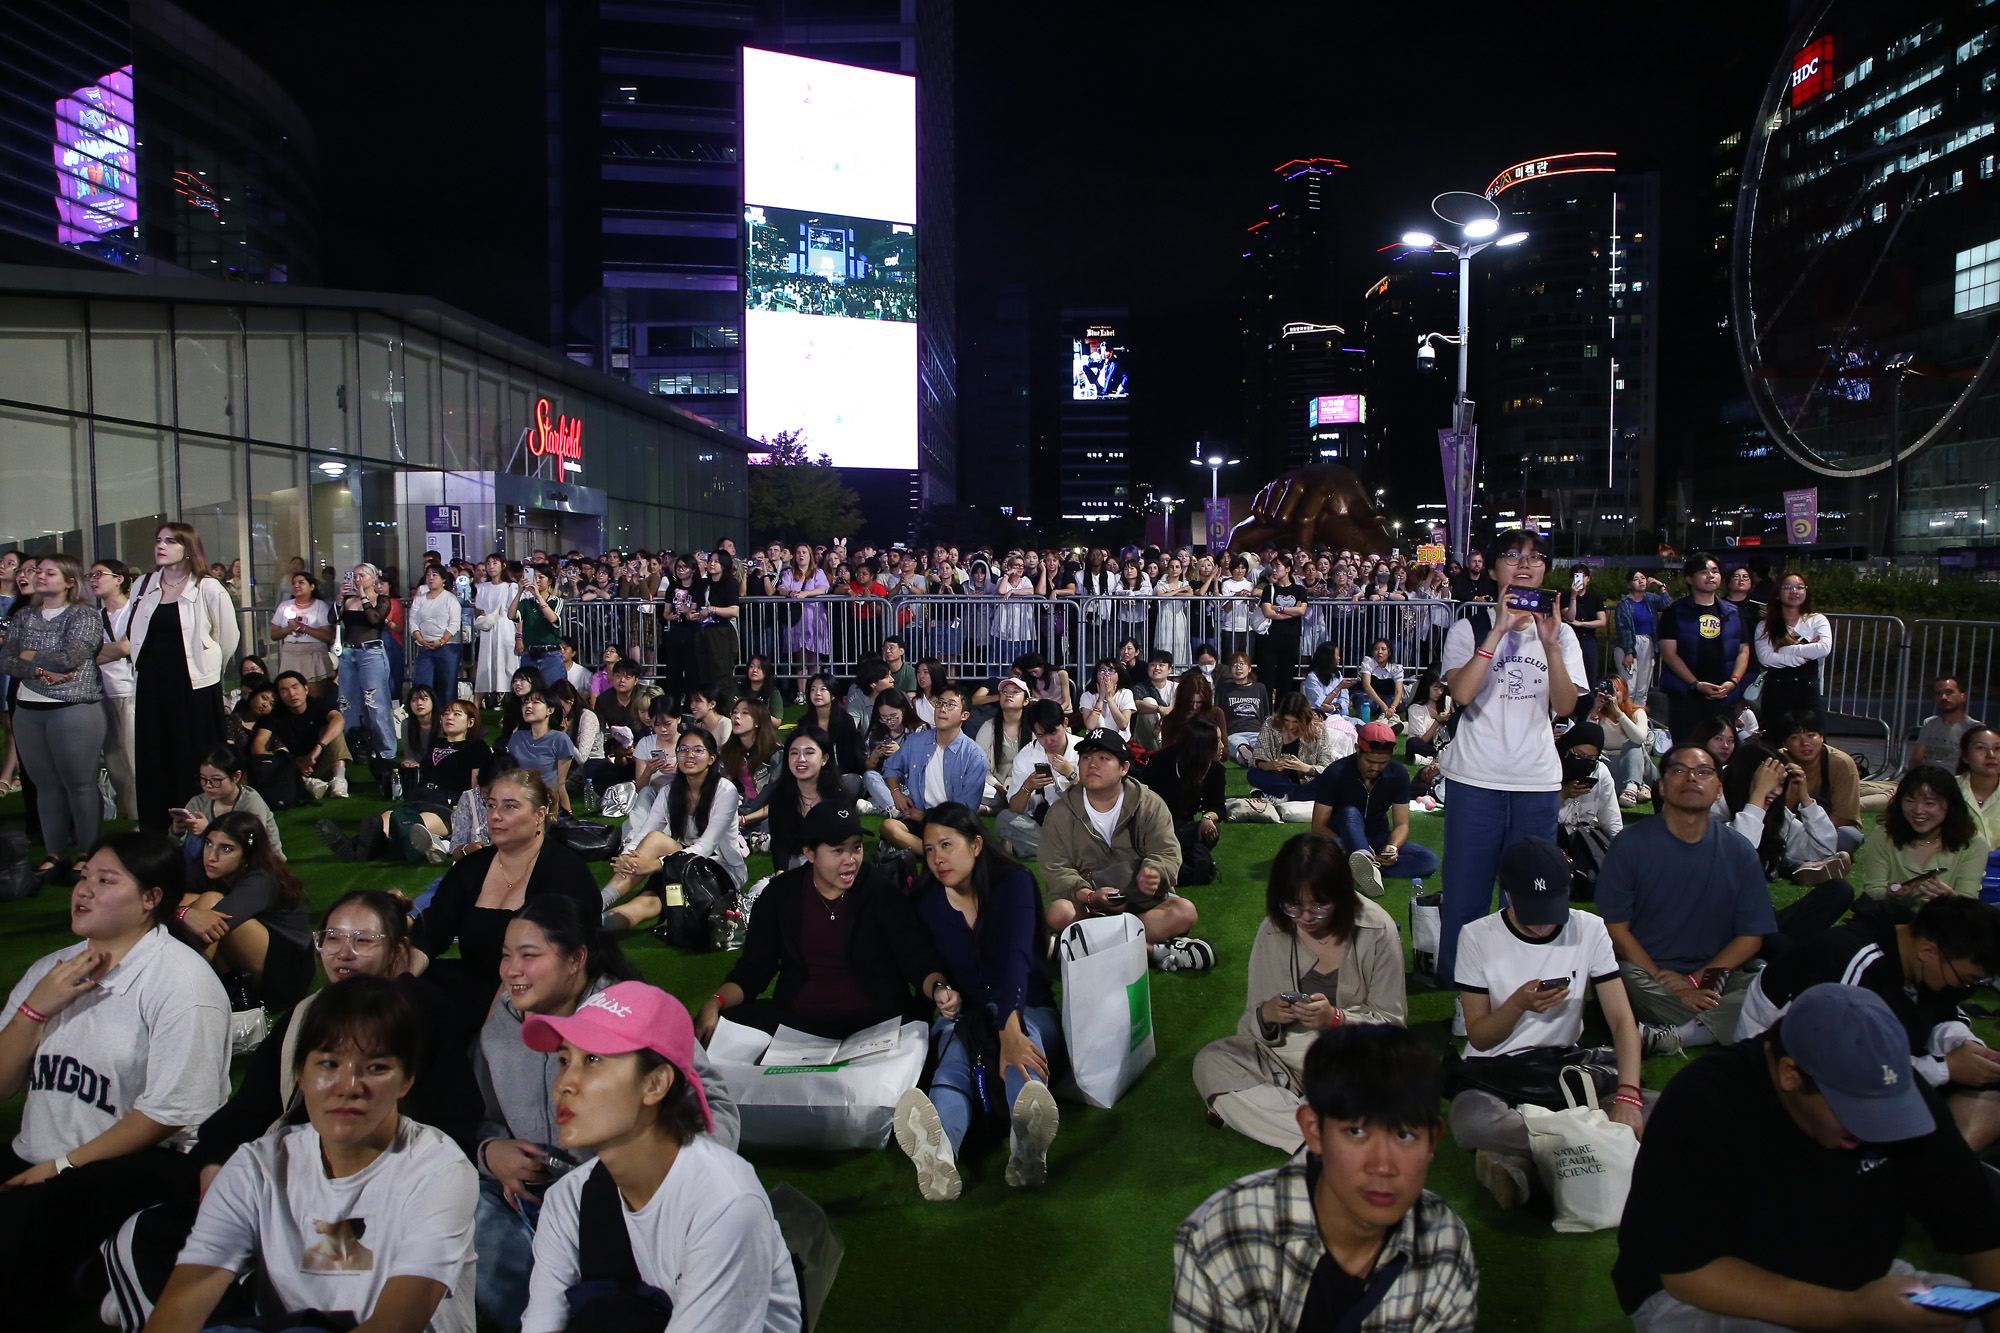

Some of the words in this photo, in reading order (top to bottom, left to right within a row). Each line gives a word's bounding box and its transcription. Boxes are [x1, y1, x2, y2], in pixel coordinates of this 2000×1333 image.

[1792, 57, 1819, 88] HDC
[528, 399, 582, 483] Starfield
[1524, 656, 1548, 672] CLUB
[1090, 728, 1104, 739] NY
[1533, 877, 1547, 891] NY
[1881, 1064, 1898, 1085] LA
[1553, 1144, 1596, 1157] NATURE.
[1556, 1155, 1598, 1169] HEALTH.
[1557, 1164, 1606, 1180] SCIENCE.
